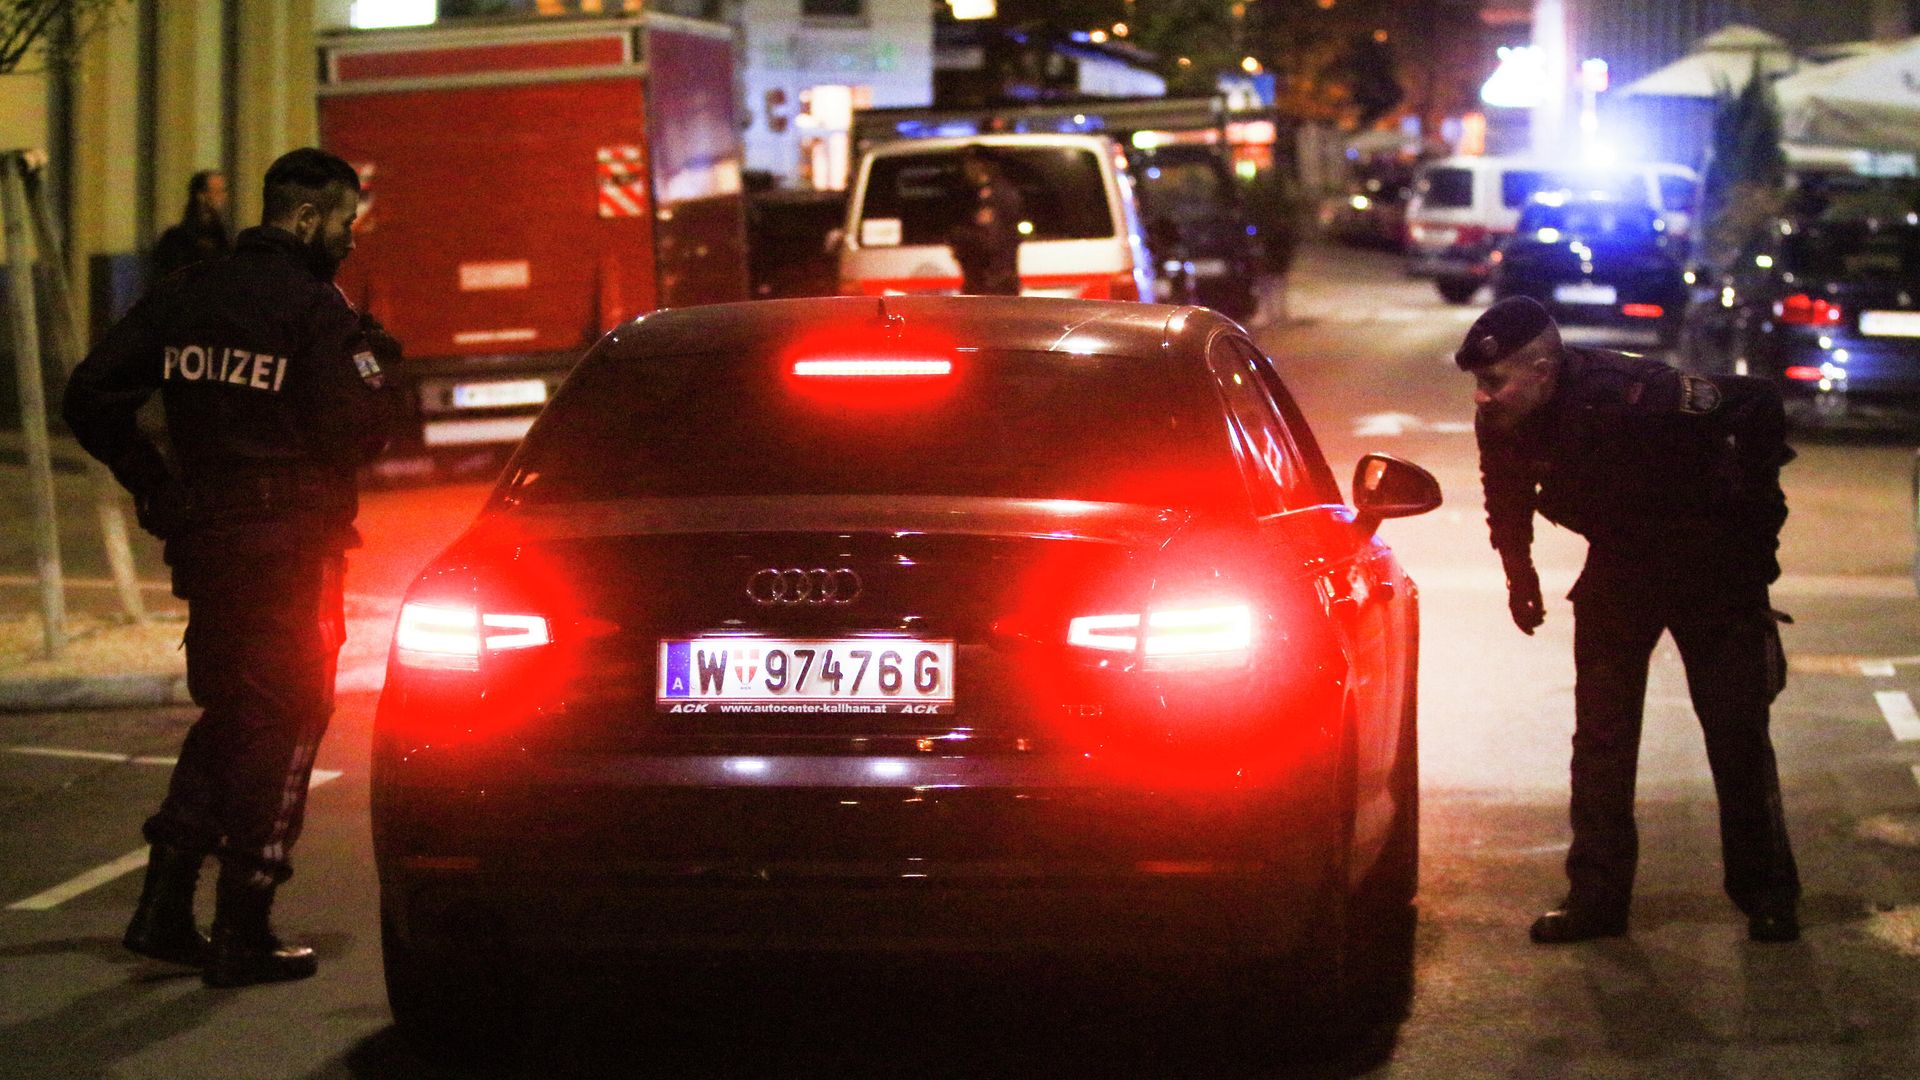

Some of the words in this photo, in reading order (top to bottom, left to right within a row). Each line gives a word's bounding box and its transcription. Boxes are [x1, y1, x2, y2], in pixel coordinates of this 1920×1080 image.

[163, 345, 288, 391] POLIZEI
[672, 677, 684, 690] A
[697, 649, 728, 695] W
[670, 703, 709, 713] ACK
[900, 704, 940, 714] ACK
